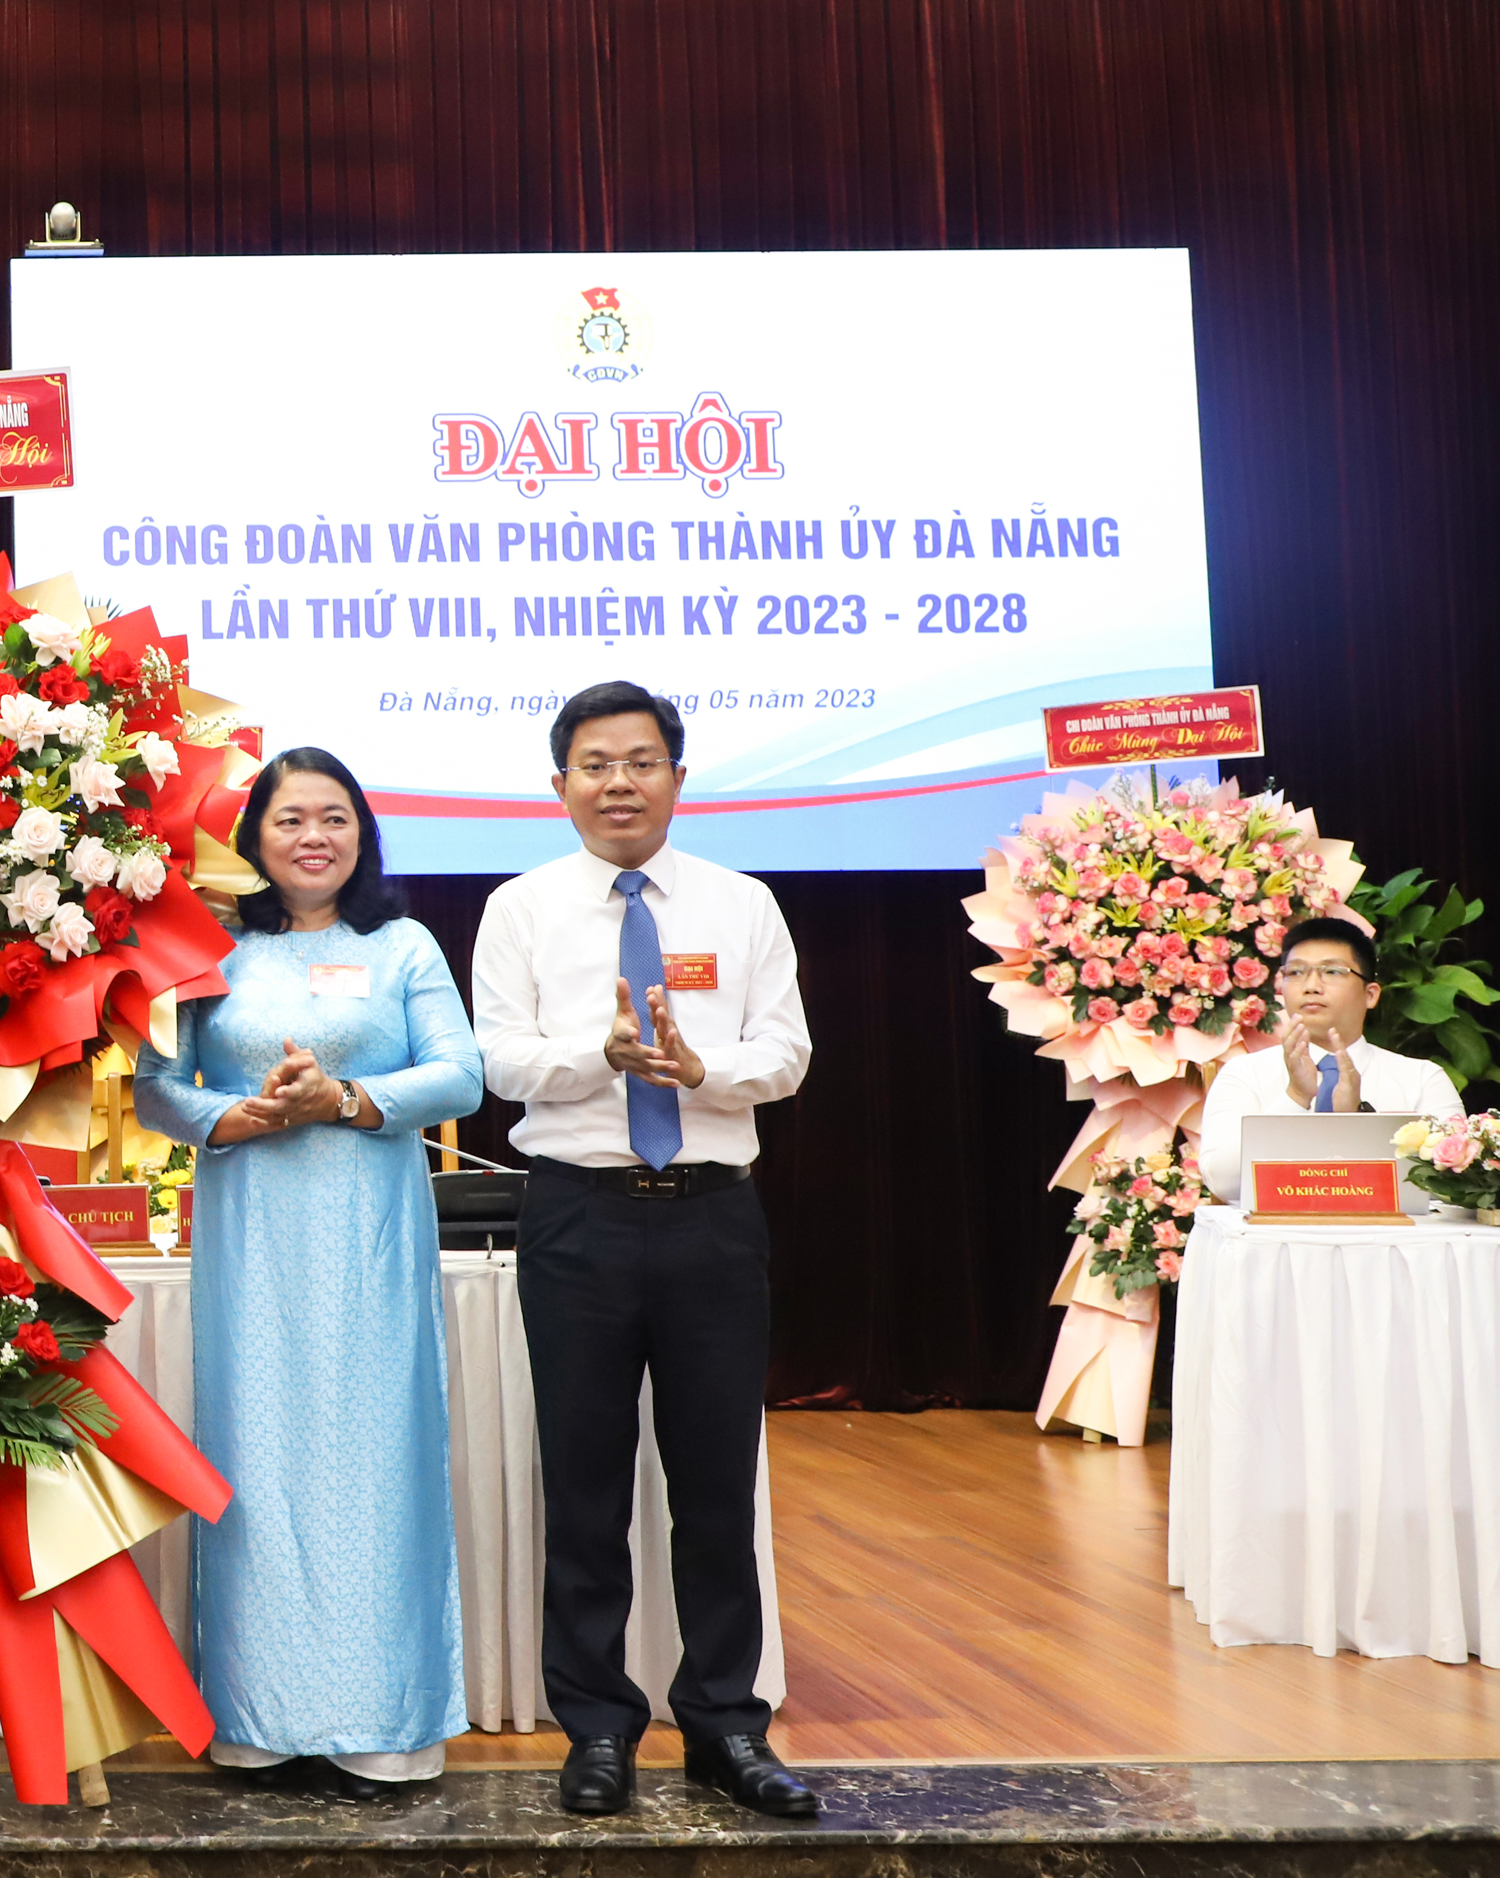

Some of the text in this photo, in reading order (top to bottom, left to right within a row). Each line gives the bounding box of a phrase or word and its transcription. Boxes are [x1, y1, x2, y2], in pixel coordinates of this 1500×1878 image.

[434, 391, 785, 499] ĐẠI HỘI
[103, 502, 1120, 567] CÔNG ĐOÀN VĂN PHÒNG THÀNH ỦY ĐÀ NẴNG
[202, 584, 1028, 646] LẦN THỨ VIII, NHIỆM KỲ 2023 - 2028
[379, 691, 413, 712] Đà
[423, 686, 498, 717] Nẵng,
[709, 690, 740, 710] 05
[748, 692, 804, 709] năm
[814, 689, 876, 709] 2023
[1066, 719, 1080, 734] CHI
[1081, 715, 1104, 732] ĐOÀN
[1104, 714, 1122, 730] VĂN
[1122, 711, 1151, 728] PHÒNG
[1151, 709, 1179, 726] THÀNH
[1179, 706, 1191, 724] ỦY
[1192, 706, 1205, 722] ĐÀ
[1061, 734, 1107, 760] Chúc
[1331, 1185, 1373, 1196] HOÀNG
[68, 1209, 134, 1225] CHỦ TỊCH
